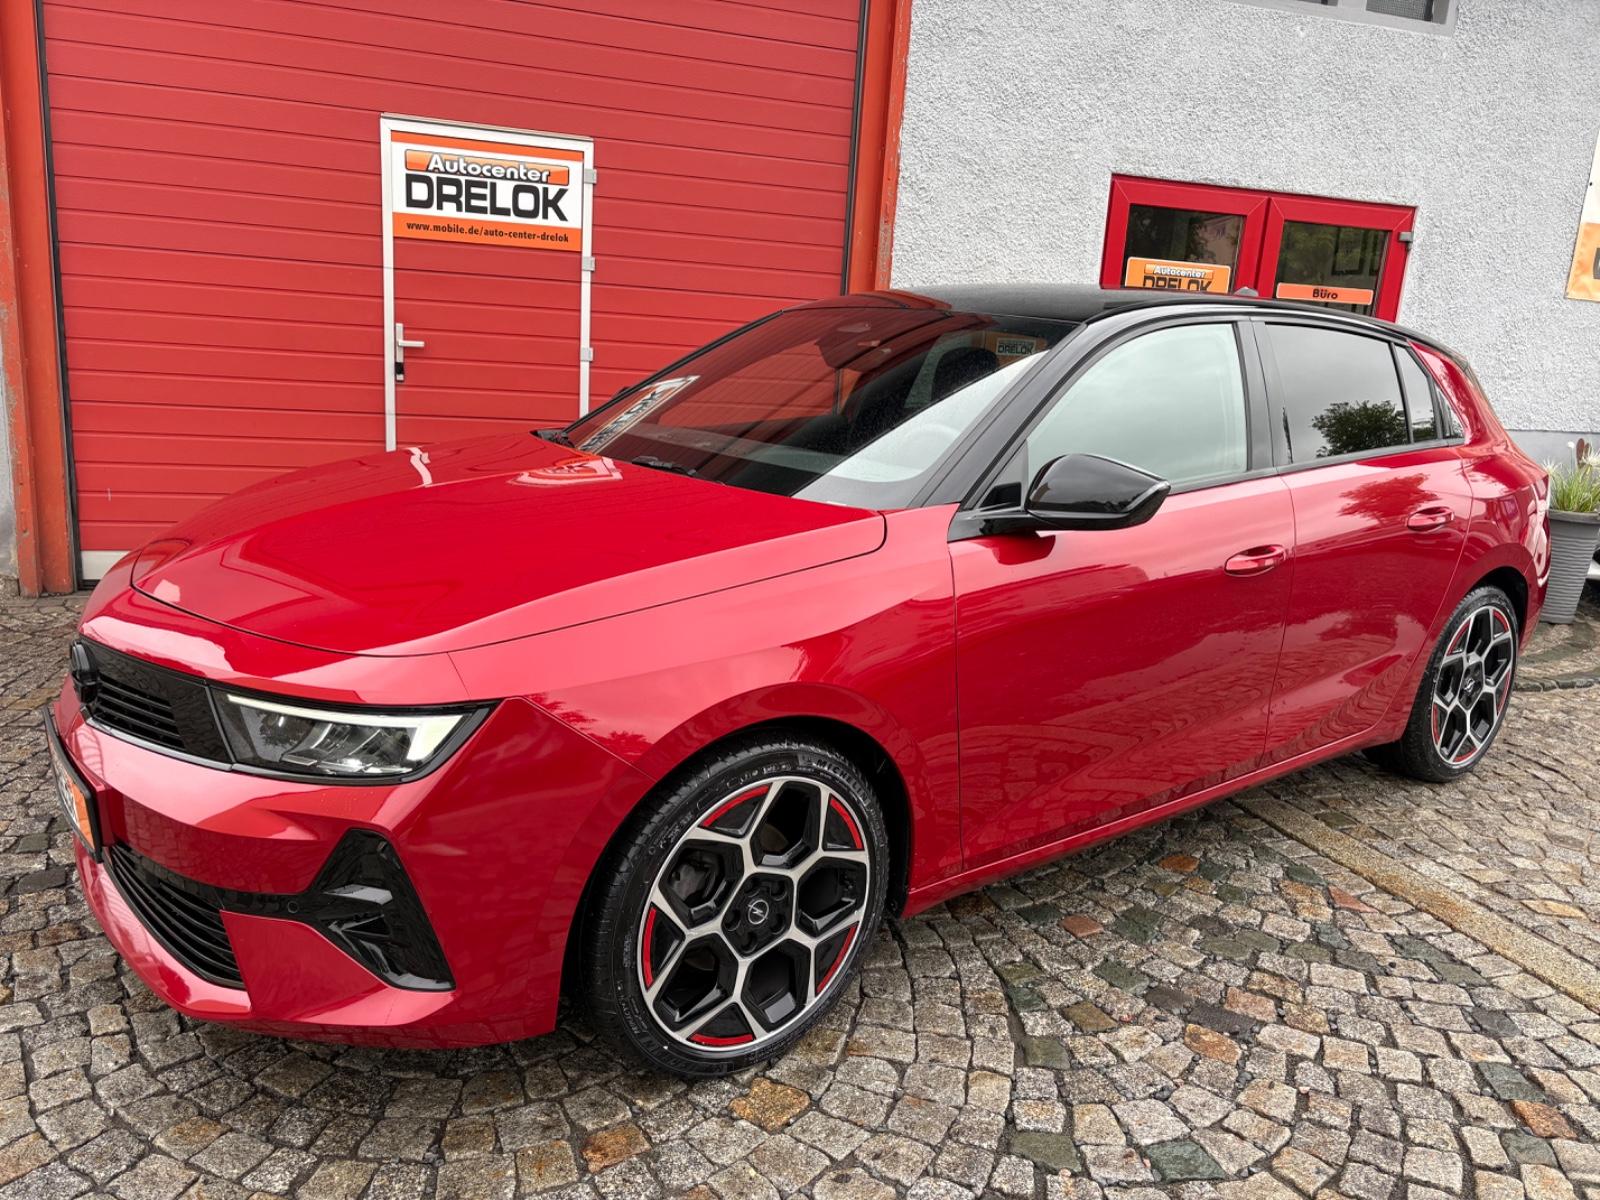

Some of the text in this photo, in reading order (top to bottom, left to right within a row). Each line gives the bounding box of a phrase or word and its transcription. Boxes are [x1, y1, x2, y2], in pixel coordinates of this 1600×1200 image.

[427, 153, 551, 183] Autocenter
[405, 173, 569, 222] DRELOK
[406, 222, 569, 242] www.mobile.de/auto-center-drelok
[1153, 265, 1206, 279] Autocenter
[1312, 288, 1338, 300] Büro
[816, 758, 869, 802] MICHELIN
